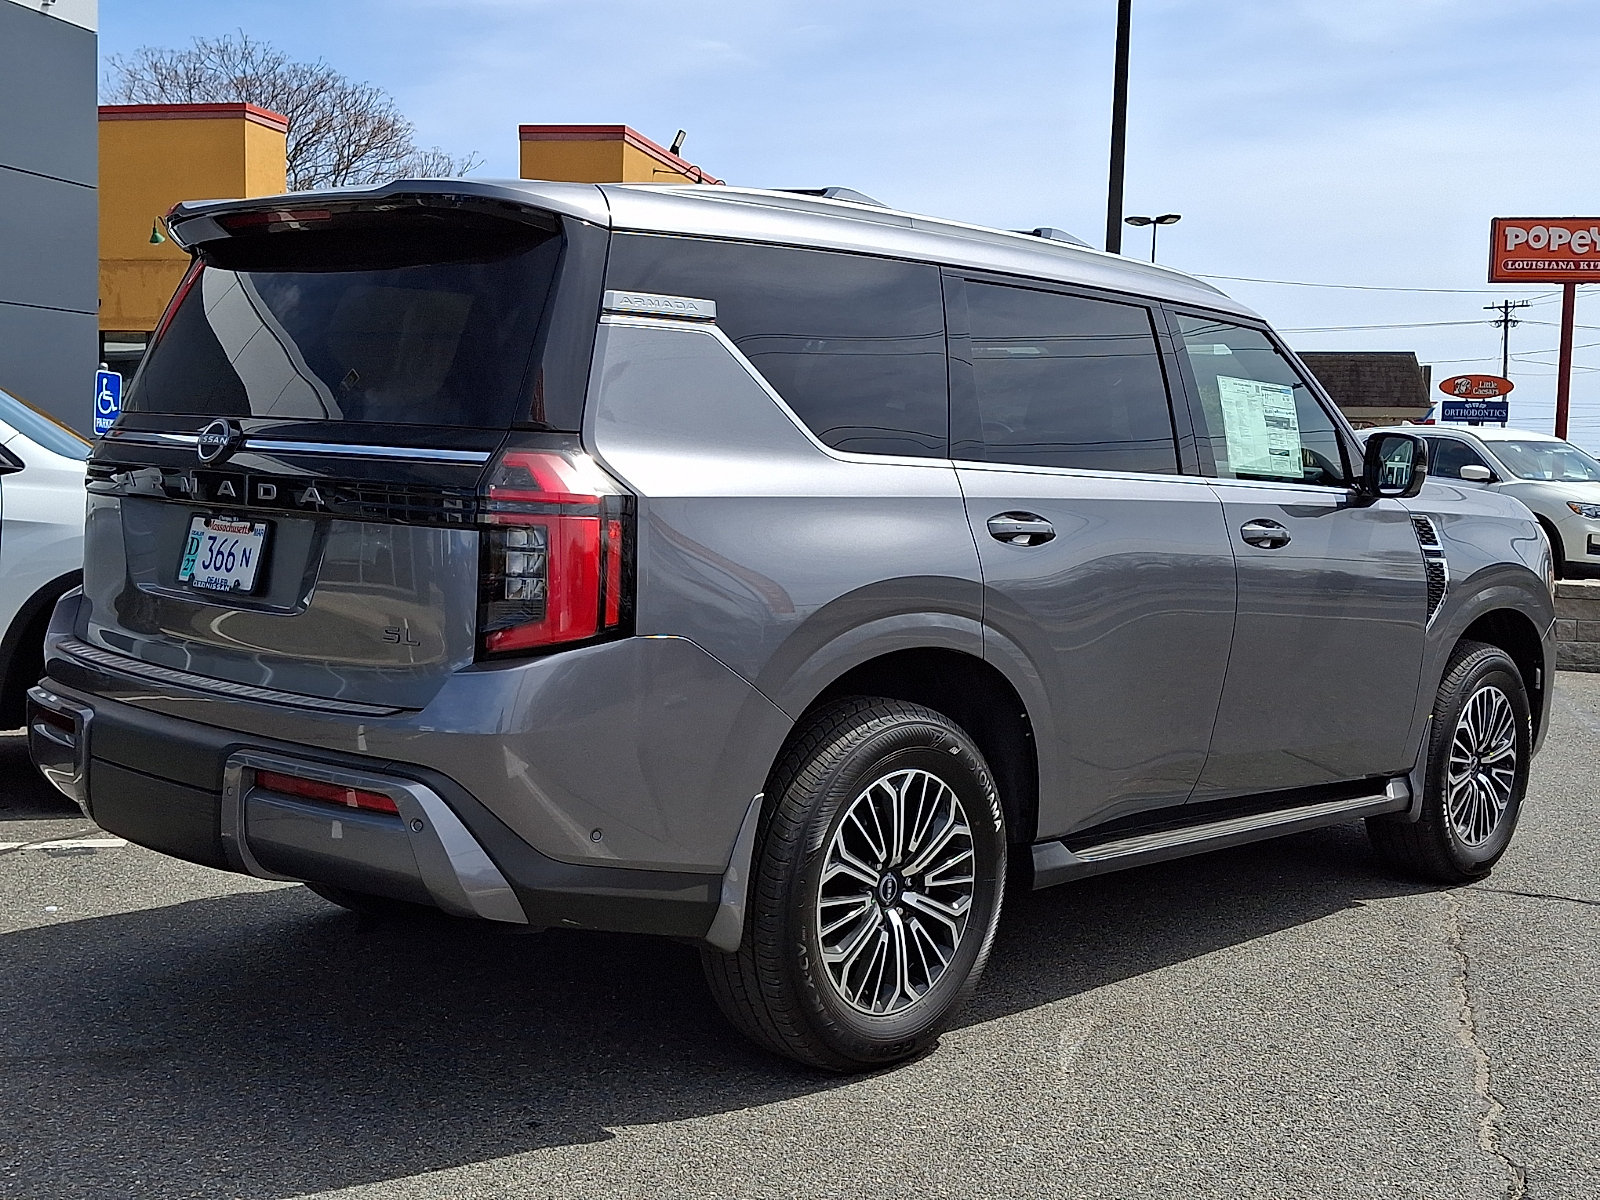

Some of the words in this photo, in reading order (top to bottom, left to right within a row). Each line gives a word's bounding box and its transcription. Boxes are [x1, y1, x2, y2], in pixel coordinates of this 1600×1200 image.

[1507, 260, 1576, 270] LOUISIANA
[619, 295, 699, 311] ARMADA
[1472, 387, 1500, 395] Caesars
[1479, 380, 1498, 389] Little
[1444, 408, 1507, 417] ORTHODONTICS
[121, 470, 325, 506] ARMADA
[208, 520, 251, 535] Massachusetts
[187, 536, 200, 556] D
[201, 535, 239, 573] 366
[239, 547, 252, 568] N
[183, 558, 196, 572] 27
[206, 576, 229, 585] DEALER
[382, 625, 421, 647] SL
